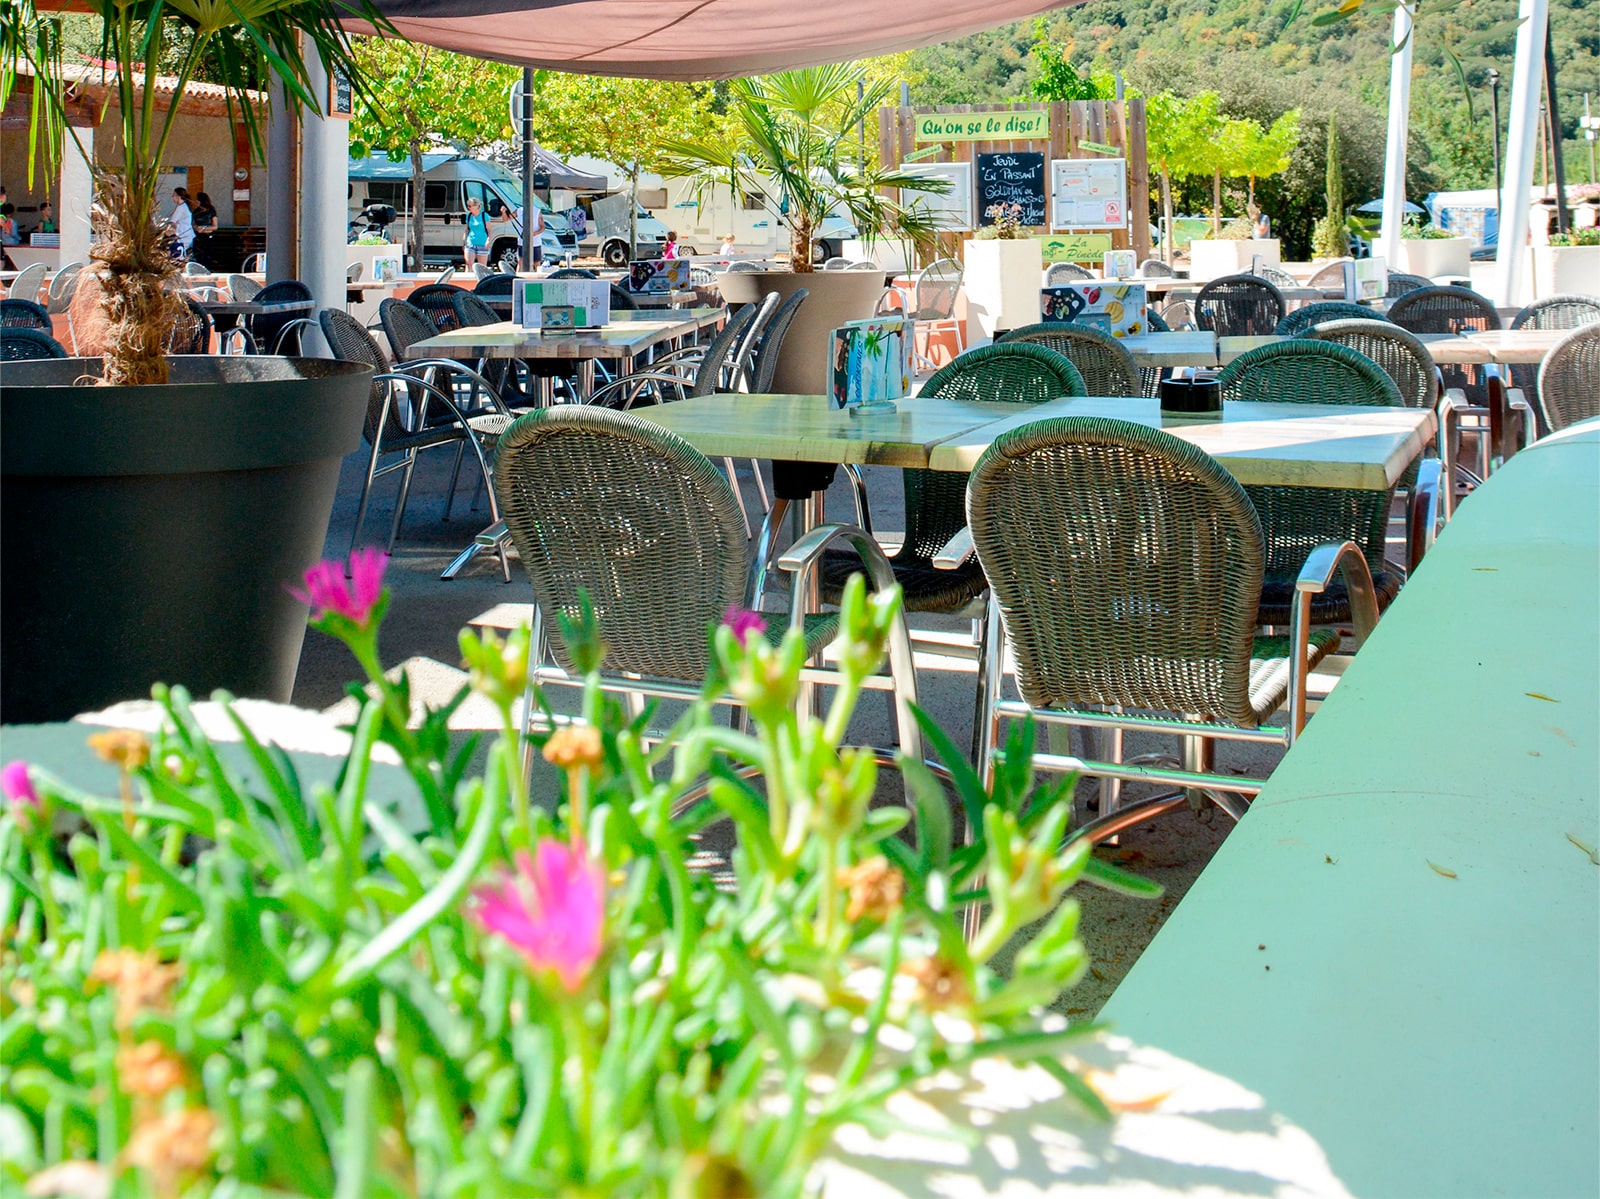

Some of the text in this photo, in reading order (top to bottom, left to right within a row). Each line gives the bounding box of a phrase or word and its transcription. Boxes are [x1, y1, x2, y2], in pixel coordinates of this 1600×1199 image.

[922, 118, 963, 134] Qu'on
[967, 122, 982, 135] se
[986, 118, 1001, 133] le
[1071, 237, 1087, 248] La
